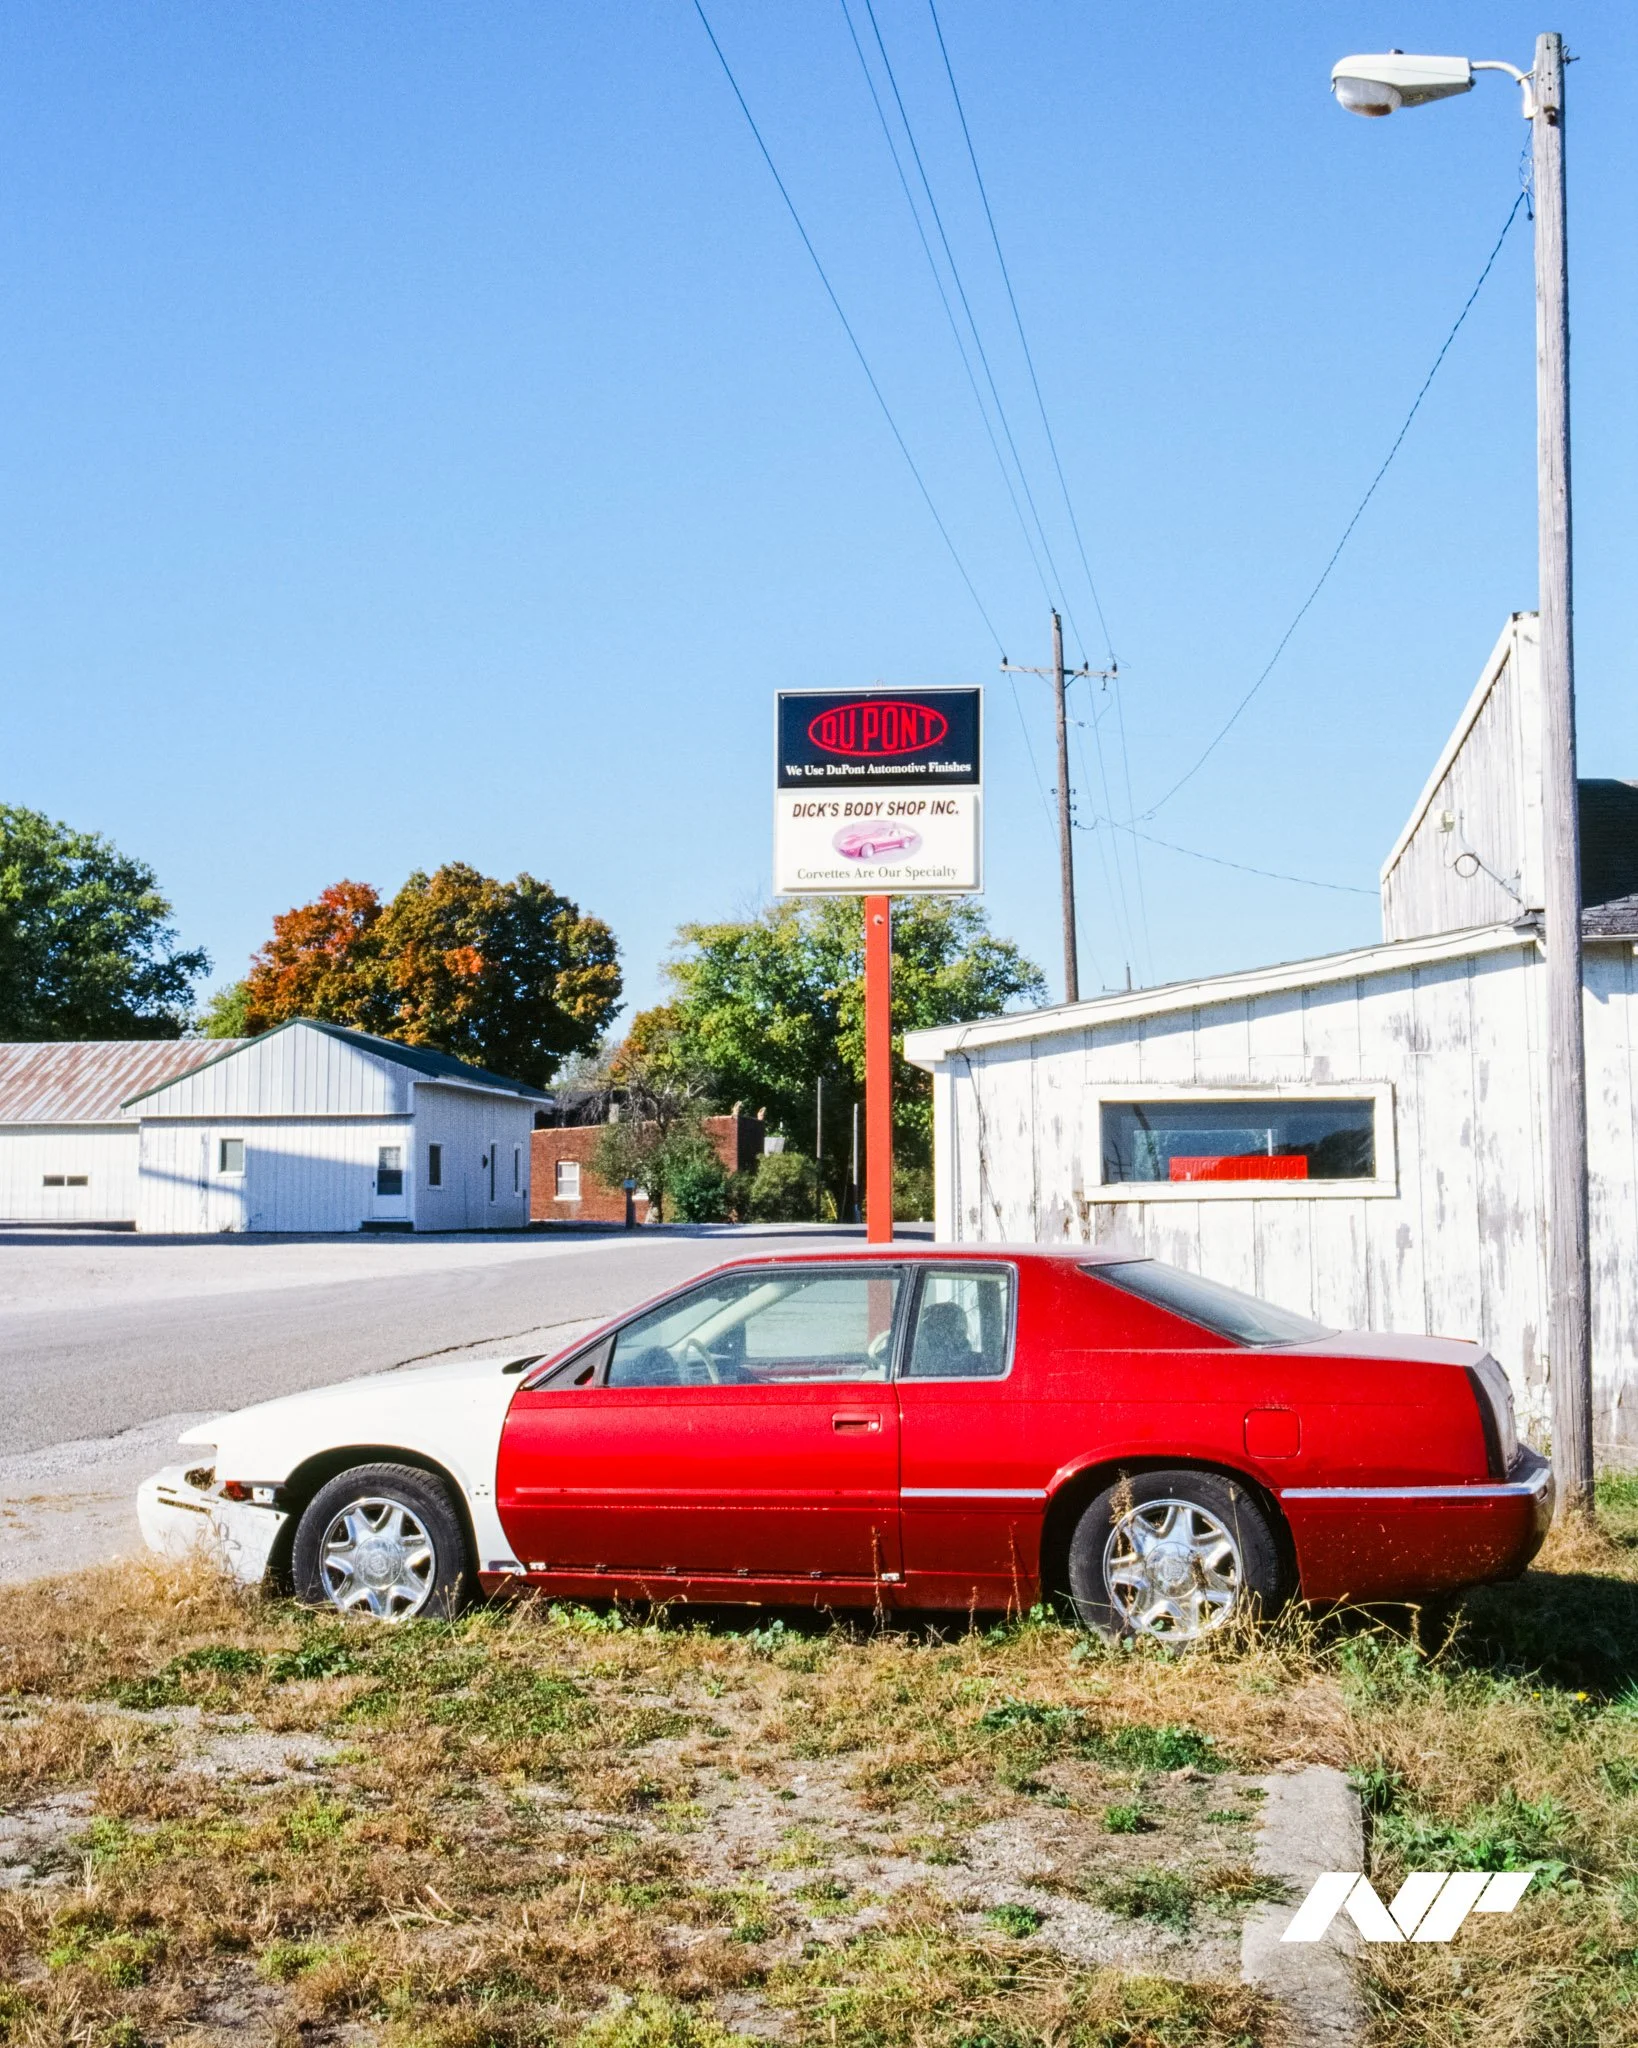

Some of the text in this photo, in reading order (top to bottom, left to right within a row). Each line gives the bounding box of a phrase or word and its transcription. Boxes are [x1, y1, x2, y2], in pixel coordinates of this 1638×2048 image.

[785, 761, 972, 776] We Use DuPont Automotive Finishes
[792, 800, 960, 818] DICK'S BODY SHOP INC.
[797, 865, 958, 881] Corvettes Are Our Specialty
